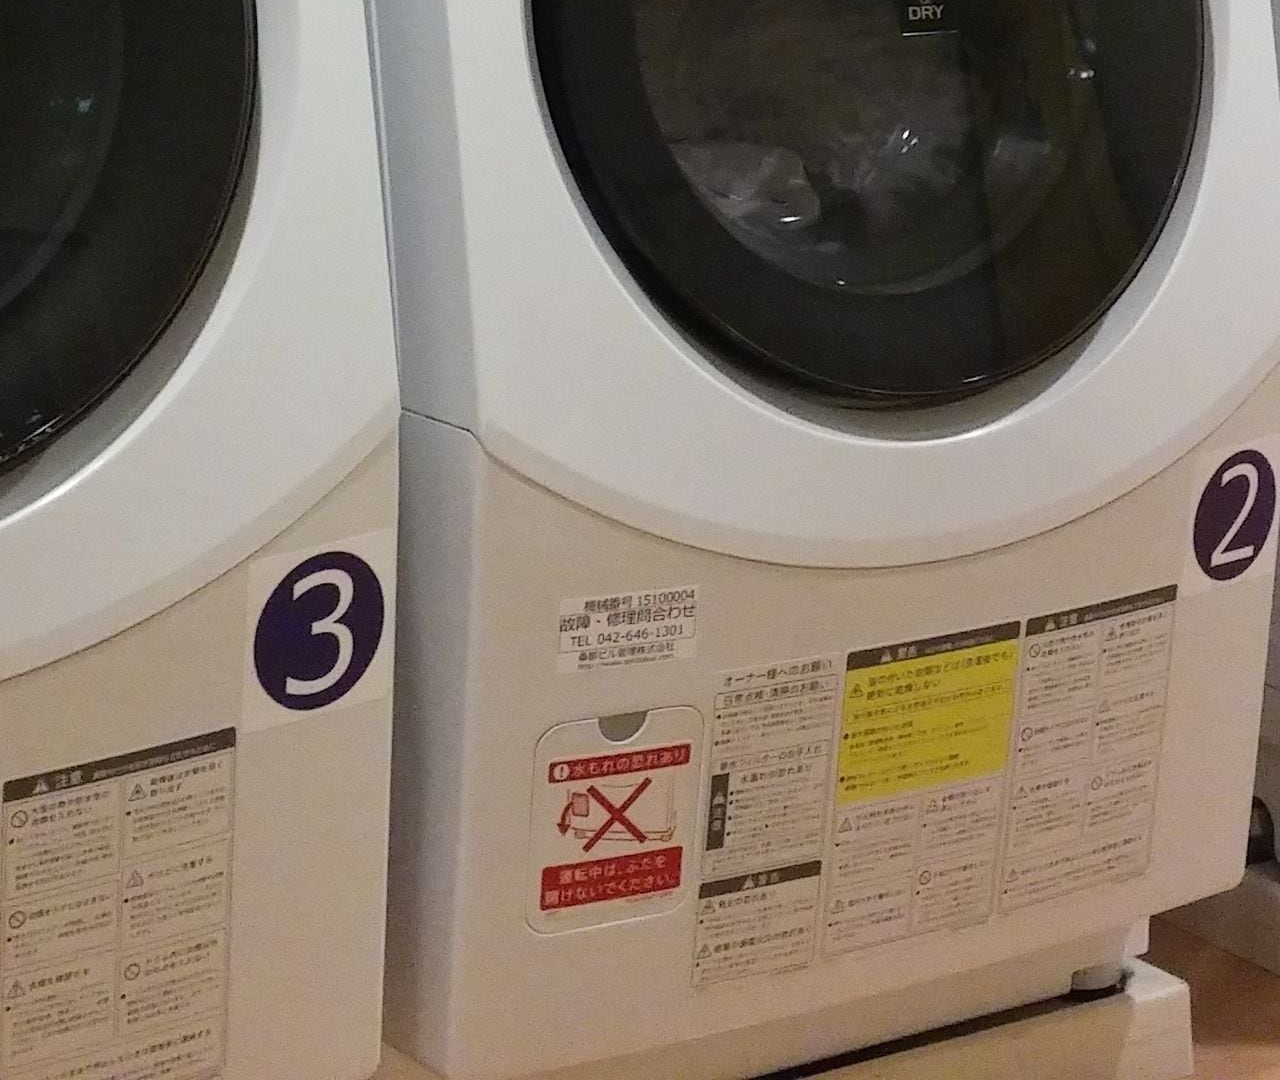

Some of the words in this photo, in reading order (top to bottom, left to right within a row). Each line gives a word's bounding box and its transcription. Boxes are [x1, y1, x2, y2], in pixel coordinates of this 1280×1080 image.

[908, 5, 944, 21] DRY
[1210, 463, 1259, 567] 2
[637, 589, 695, 607] 15100004
[285, 568, 355, 696] 3
[570, 636, 591, 647] TEL
[597, 624, 683, 645] 042-646-1301
